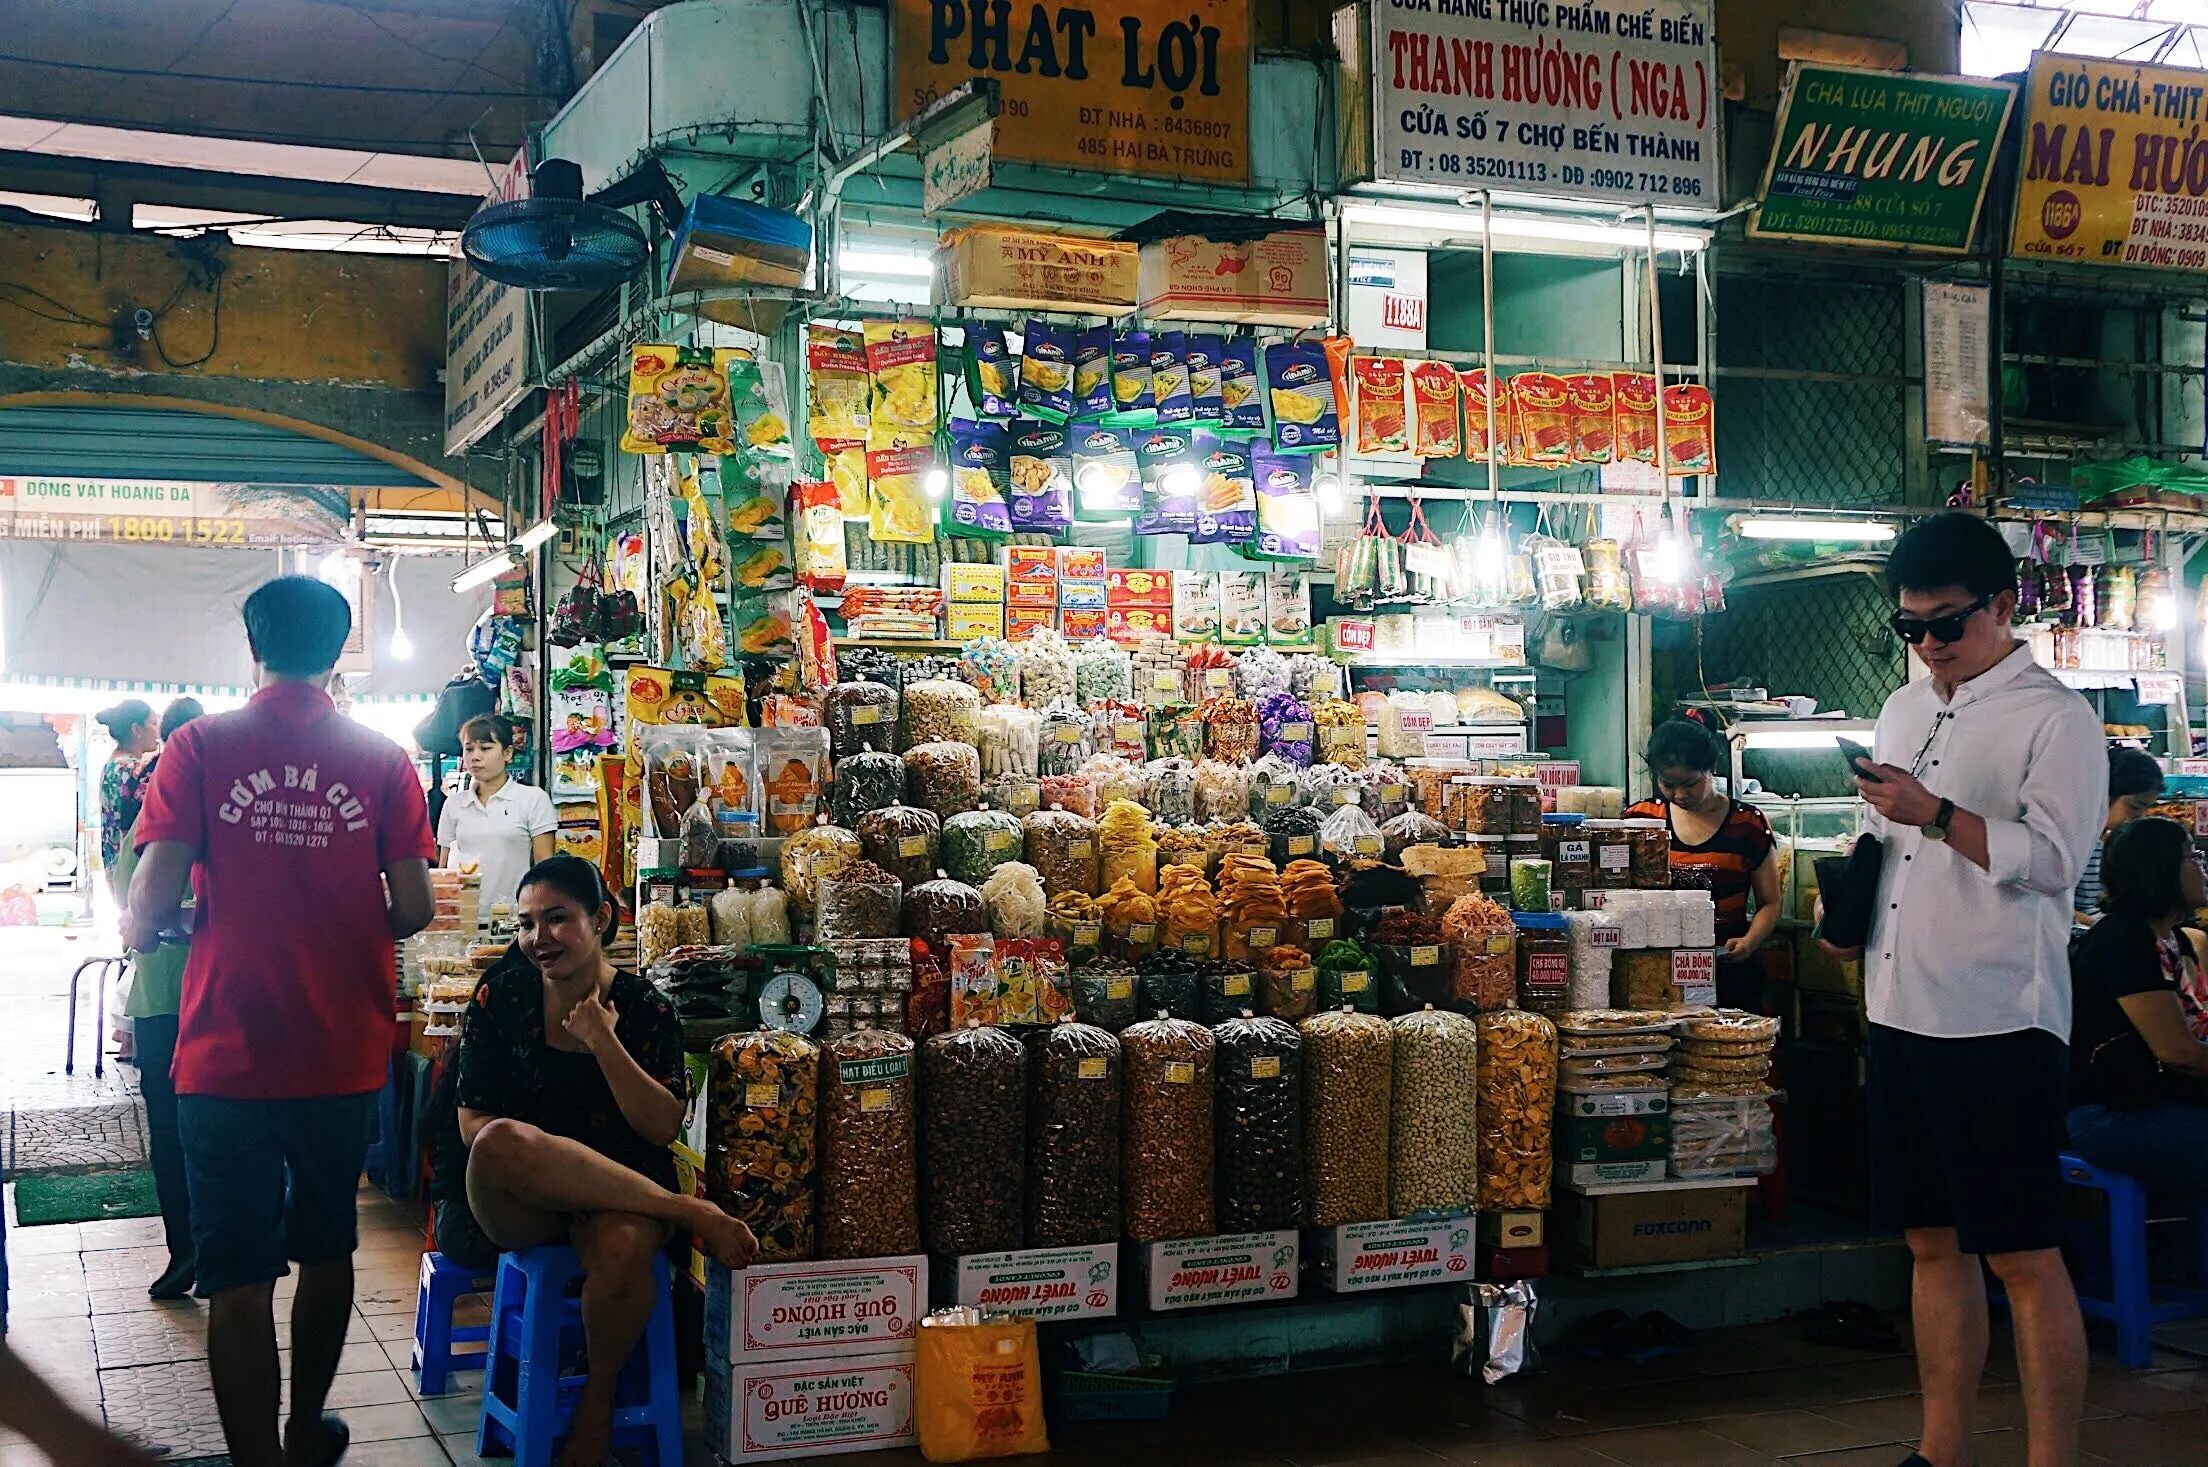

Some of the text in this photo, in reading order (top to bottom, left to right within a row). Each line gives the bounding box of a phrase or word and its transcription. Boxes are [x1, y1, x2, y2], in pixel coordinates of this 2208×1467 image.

[1499, 0, 1549, 31] THỰC
[1556, 0, 1610, 34] PHẨM
[1616, 8, 1653, 39] CHẾ
[1660, 14, 1704, 46] BIẾN
[1119, 14, 1221, 111] LỢI
[1389, 31, 1494, 99] THANH
[1502, 34, 1601, 110] HƯƠNG
[2049, 64, 2090, 109] GIÒ
[1806, 77, 1994, 127] CHẢ LỤA THỊT NGUỘI
[1164, 116, 1231, 140] 8436807
[1400, 104, 1700, 162] CỬA SỐ 7 CHỢ BẾN THÀNH
[1077, 138, 1234, 168] 485 HAI BÀ TRƯNG
[1784, 122, 1980, 187] NHUNG
[2027, 121, 2115, 186] MAI
[1400, 150, 1423, 169] ĐT
[1440, 154, 1460, 173] 08
[1466, 157, 1546, 182] 35201113
[1563, 164, 1585, 185] DĐ
[1639, 171, 1667, 194] 712
[1672, 174, 1701, 197] 896
[1018, 247, 1106, 267] MỸ ANH
[2077, 247, 2086, 256] 7
[2102, 240, 2123, 256] ĐT
[2125, 246, 2139, 261] DI
[2178, 251, 2205, 267] 0909
[1386, 297, 1421, 328] 1188A
[77, 481, 104, 502] VẬT
[111, 485, 164, 501] HOANG
[170, 483, 190, 502] DÃ
[15, 513, 64, 539] MIỄN
[69, 516, 101, 539] PHÍ
[108, 516, 174, 541] 1800
[181, 518, 245, 543] 1522
[594, 691, 605, 704] 맛
[1403, 716, 1416, 728] CỐM
[1566, 843, 1584, 852] GÀ
[1675, 953, 1712, 968] CHÀ BÔNG
[842, 1066, 859, 1080] HẠT
[1355, 1248, 1438, 1270] TUYẾT HƯƠNG
[1023, 1272, 1060, 1280] COCONUT
[1172, 1265, 1260, 1288] TUYẾT HƯƠNG
[979, 1283, 1076, 1305] TUYẾT HƯƠNG
[773, 1296, 896, 1324] QUÊ HƯƠNG
[798, 1323, 868, 1339] ĐẶC SẢN VIỆT
[795, 1377, 864, 1393] ĐẶC SẢN VIỆT
[765, 1391, 888, 1421] QUÊ HƯƠNG
